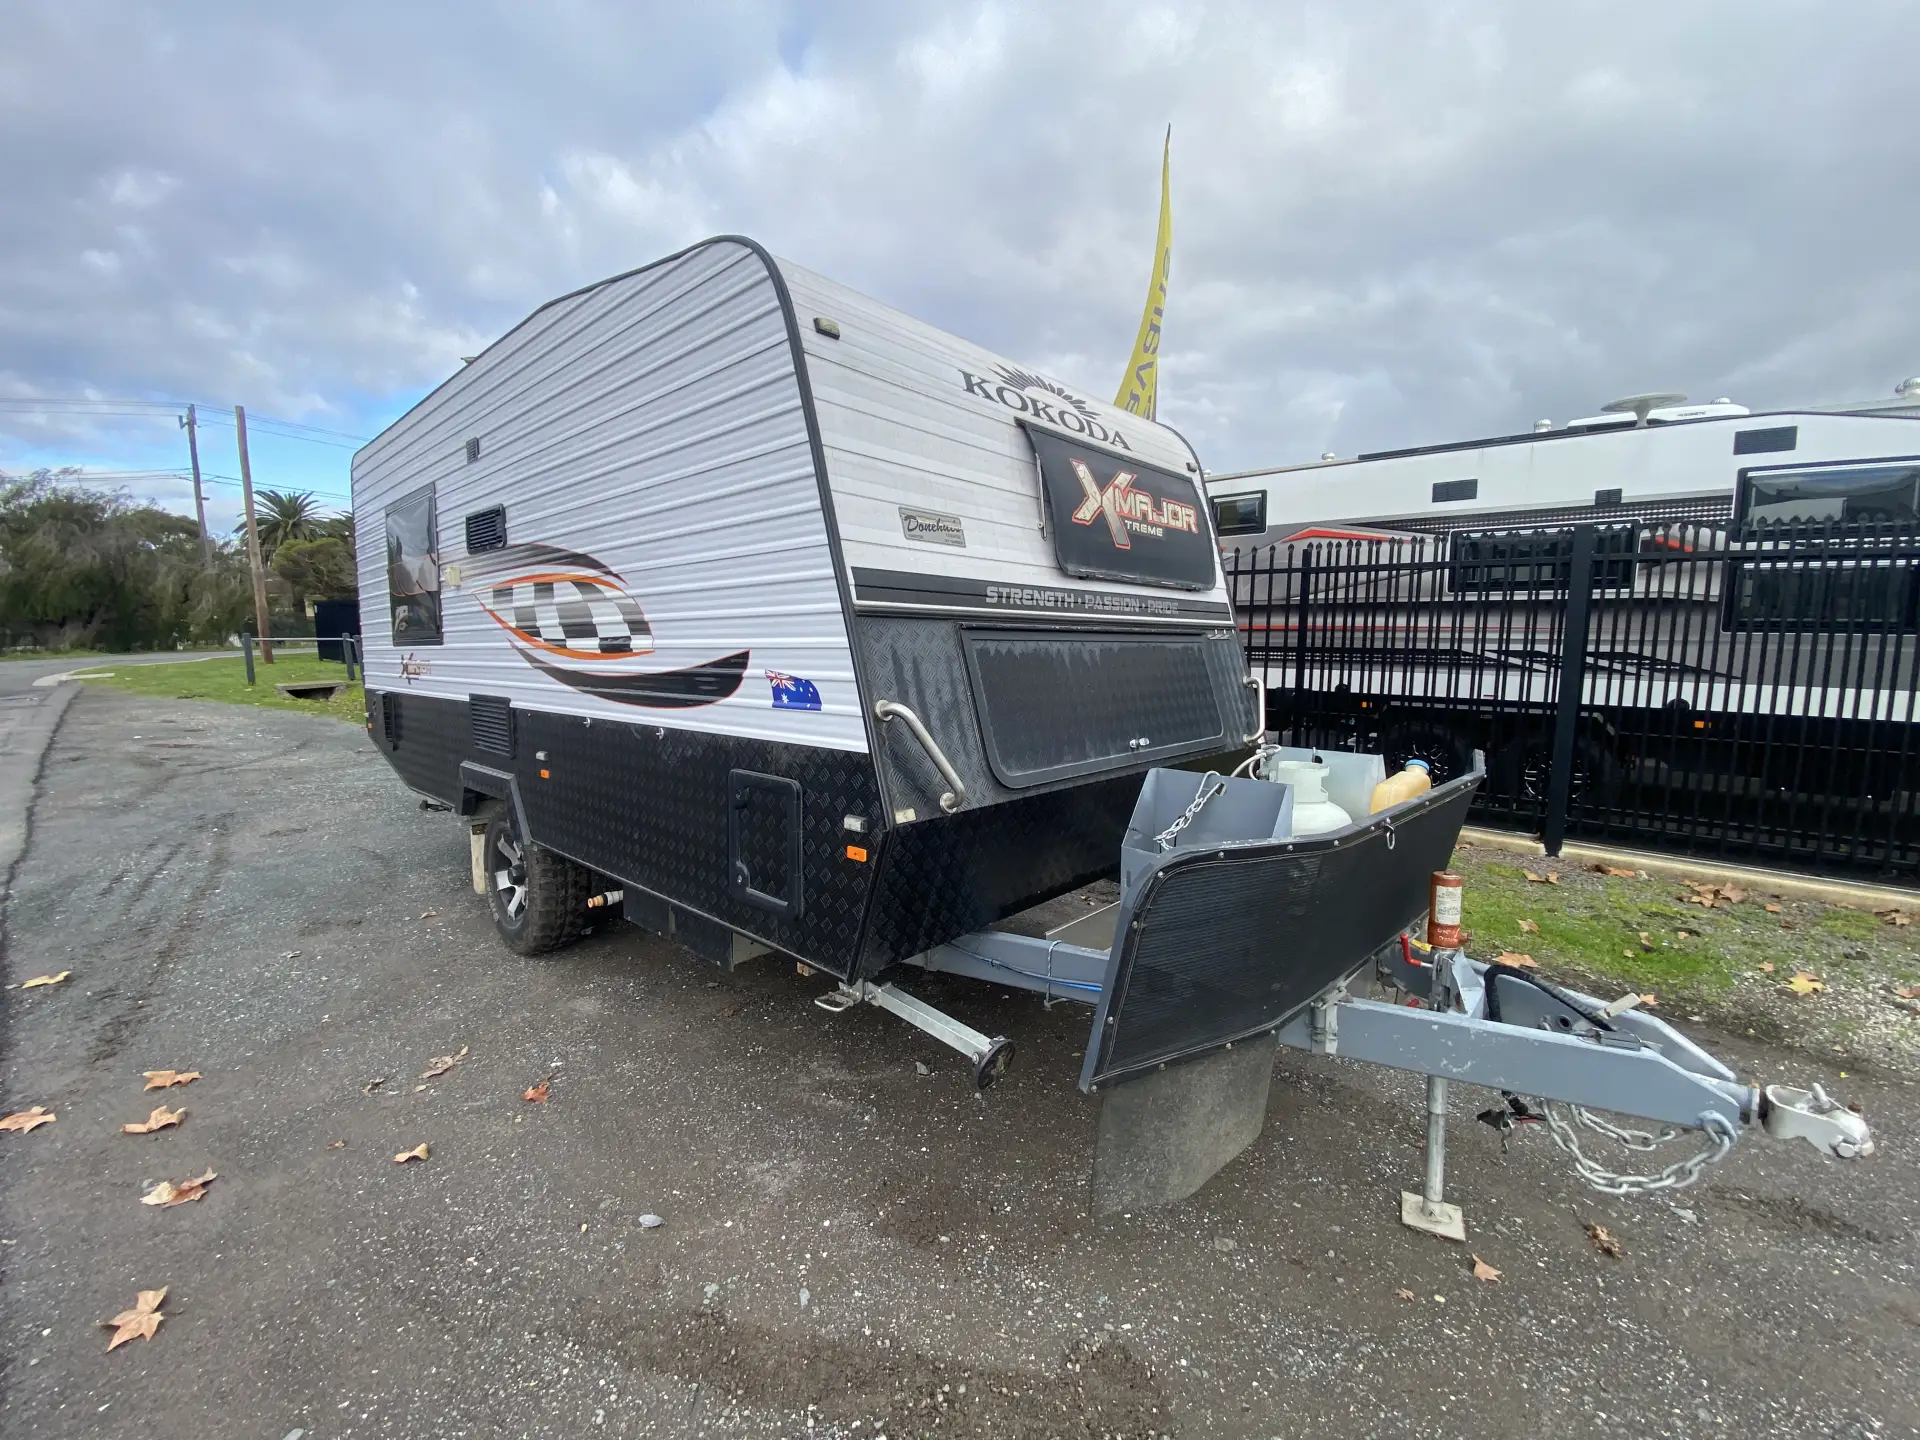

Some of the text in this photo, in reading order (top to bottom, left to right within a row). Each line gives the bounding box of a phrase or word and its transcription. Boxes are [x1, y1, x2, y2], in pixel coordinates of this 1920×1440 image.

[957, 368, 1133, 452] KOKODA
[1113, 485, 1199, 534] MAJOR
[985, 586, 1179, 615] STRENGTH PASSION PRIDE
